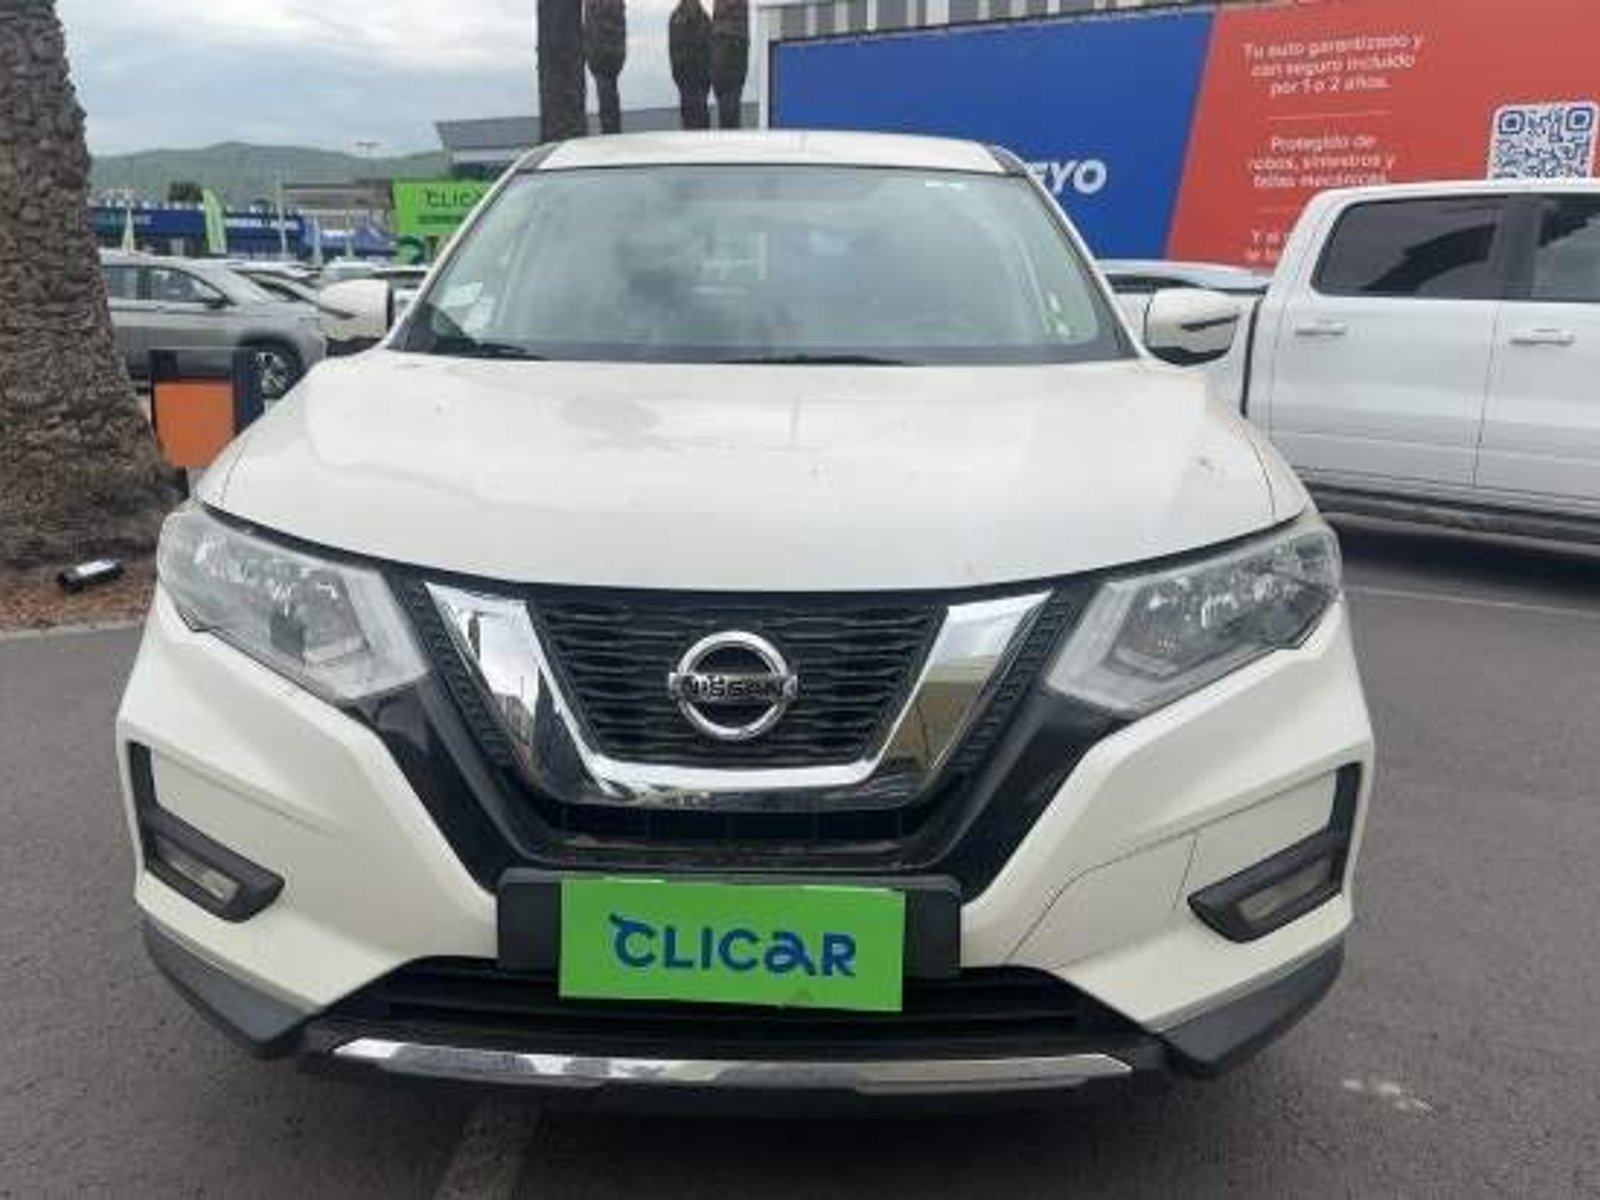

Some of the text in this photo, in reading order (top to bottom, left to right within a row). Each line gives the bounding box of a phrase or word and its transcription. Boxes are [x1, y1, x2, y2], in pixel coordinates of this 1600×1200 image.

[1267, 42, 1305, 58] auto
[1309, 34, 1410, 55] garantizado
[1286, 60, 1343, 79] seguro
[1347, 53, 1416, 73] incluido
[1270, 80, 1298, 98] por
